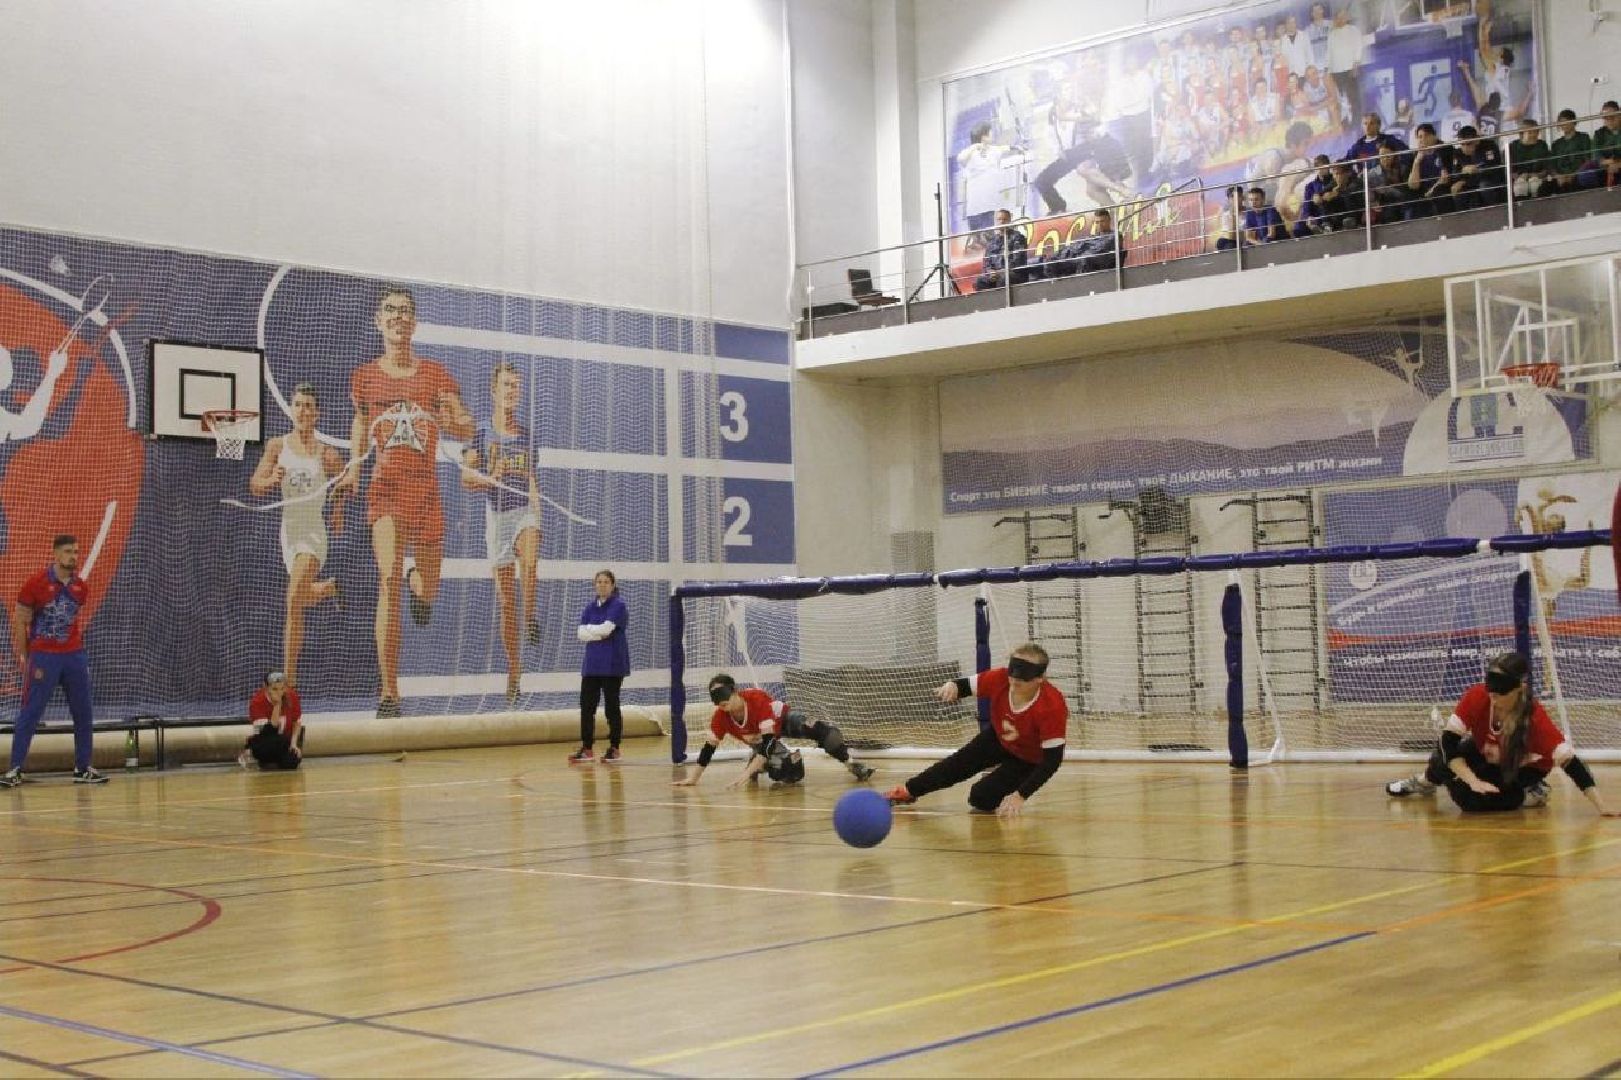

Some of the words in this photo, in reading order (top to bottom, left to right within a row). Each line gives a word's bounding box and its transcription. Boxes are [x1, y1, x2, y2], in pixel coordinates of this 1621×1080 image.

[719, 391, 749, 442] 3
[1296, 458, 1335, 473] РИТМ
[723, 496, 752, 547] 2
